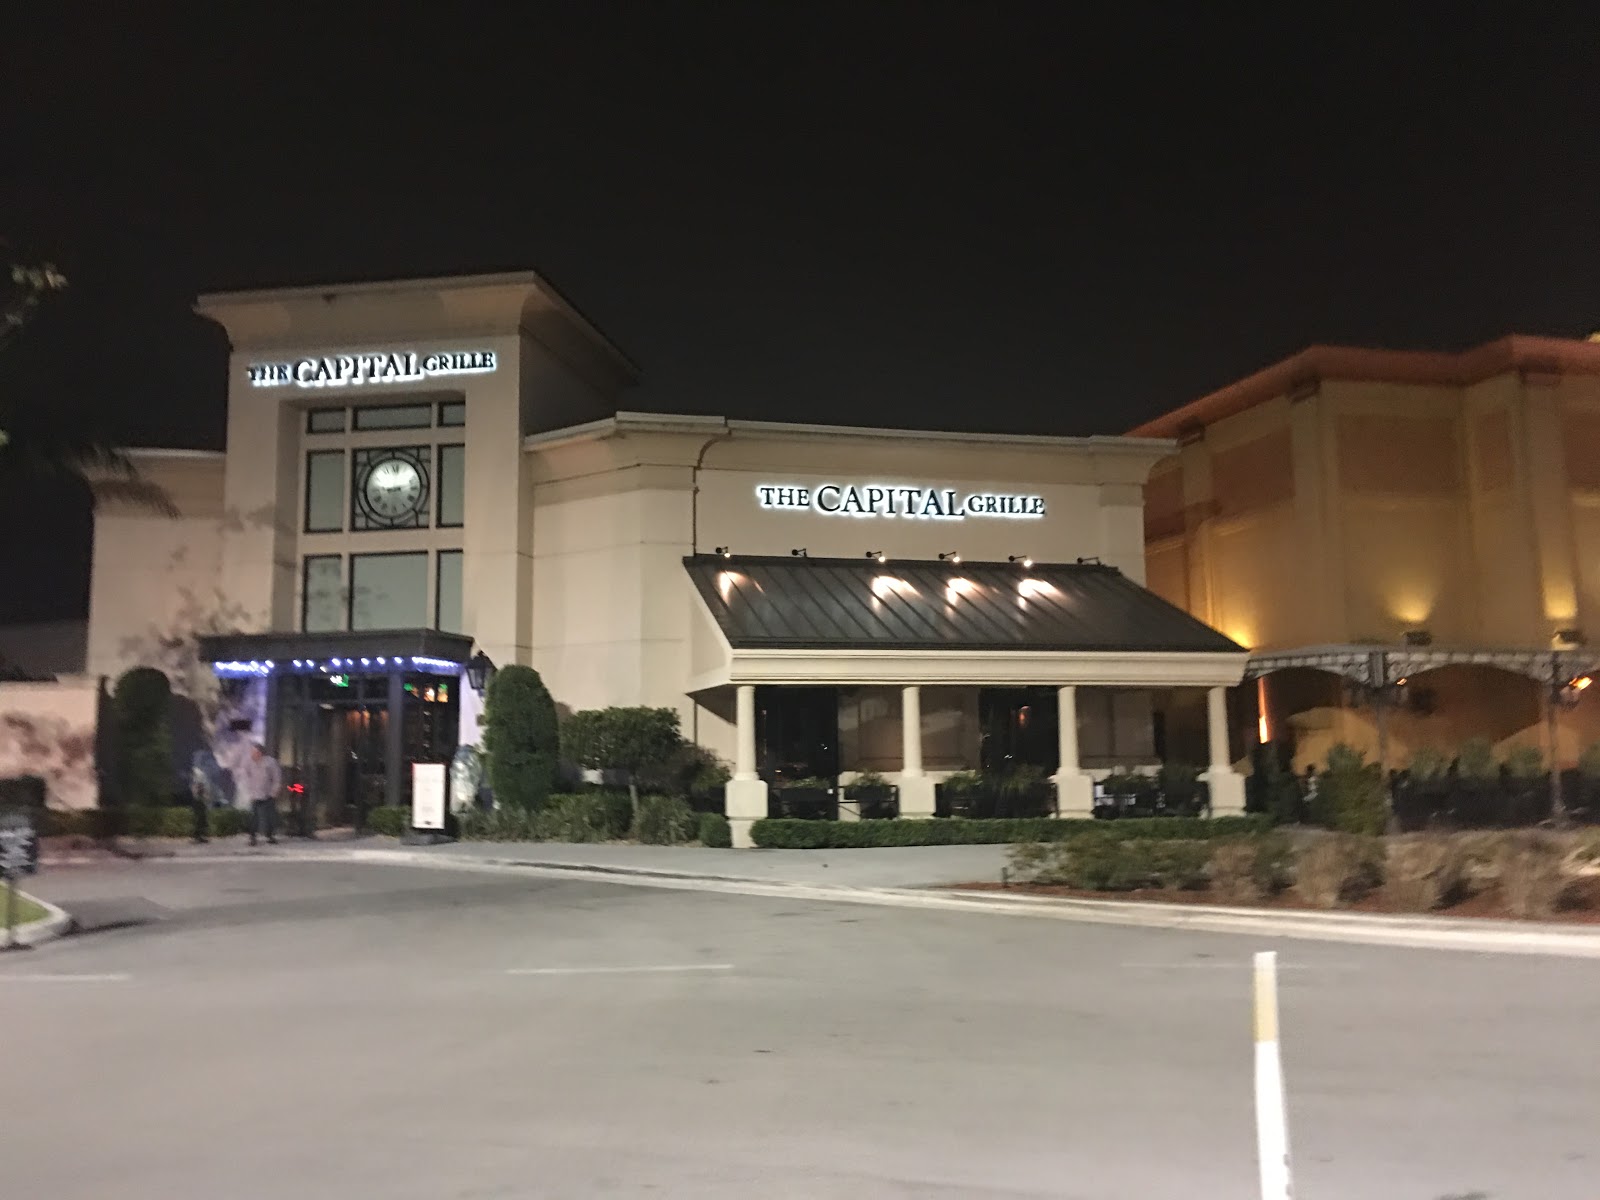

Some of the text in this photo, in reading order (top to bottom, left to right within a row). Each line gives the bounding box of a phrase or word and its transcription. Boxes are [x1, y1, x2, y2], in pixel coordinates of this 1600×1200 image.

[247, 351, 495, 384] THE CAPITAL GRILLE
[759, 485, 1046, 517] THE CAPITAL GRILLE
